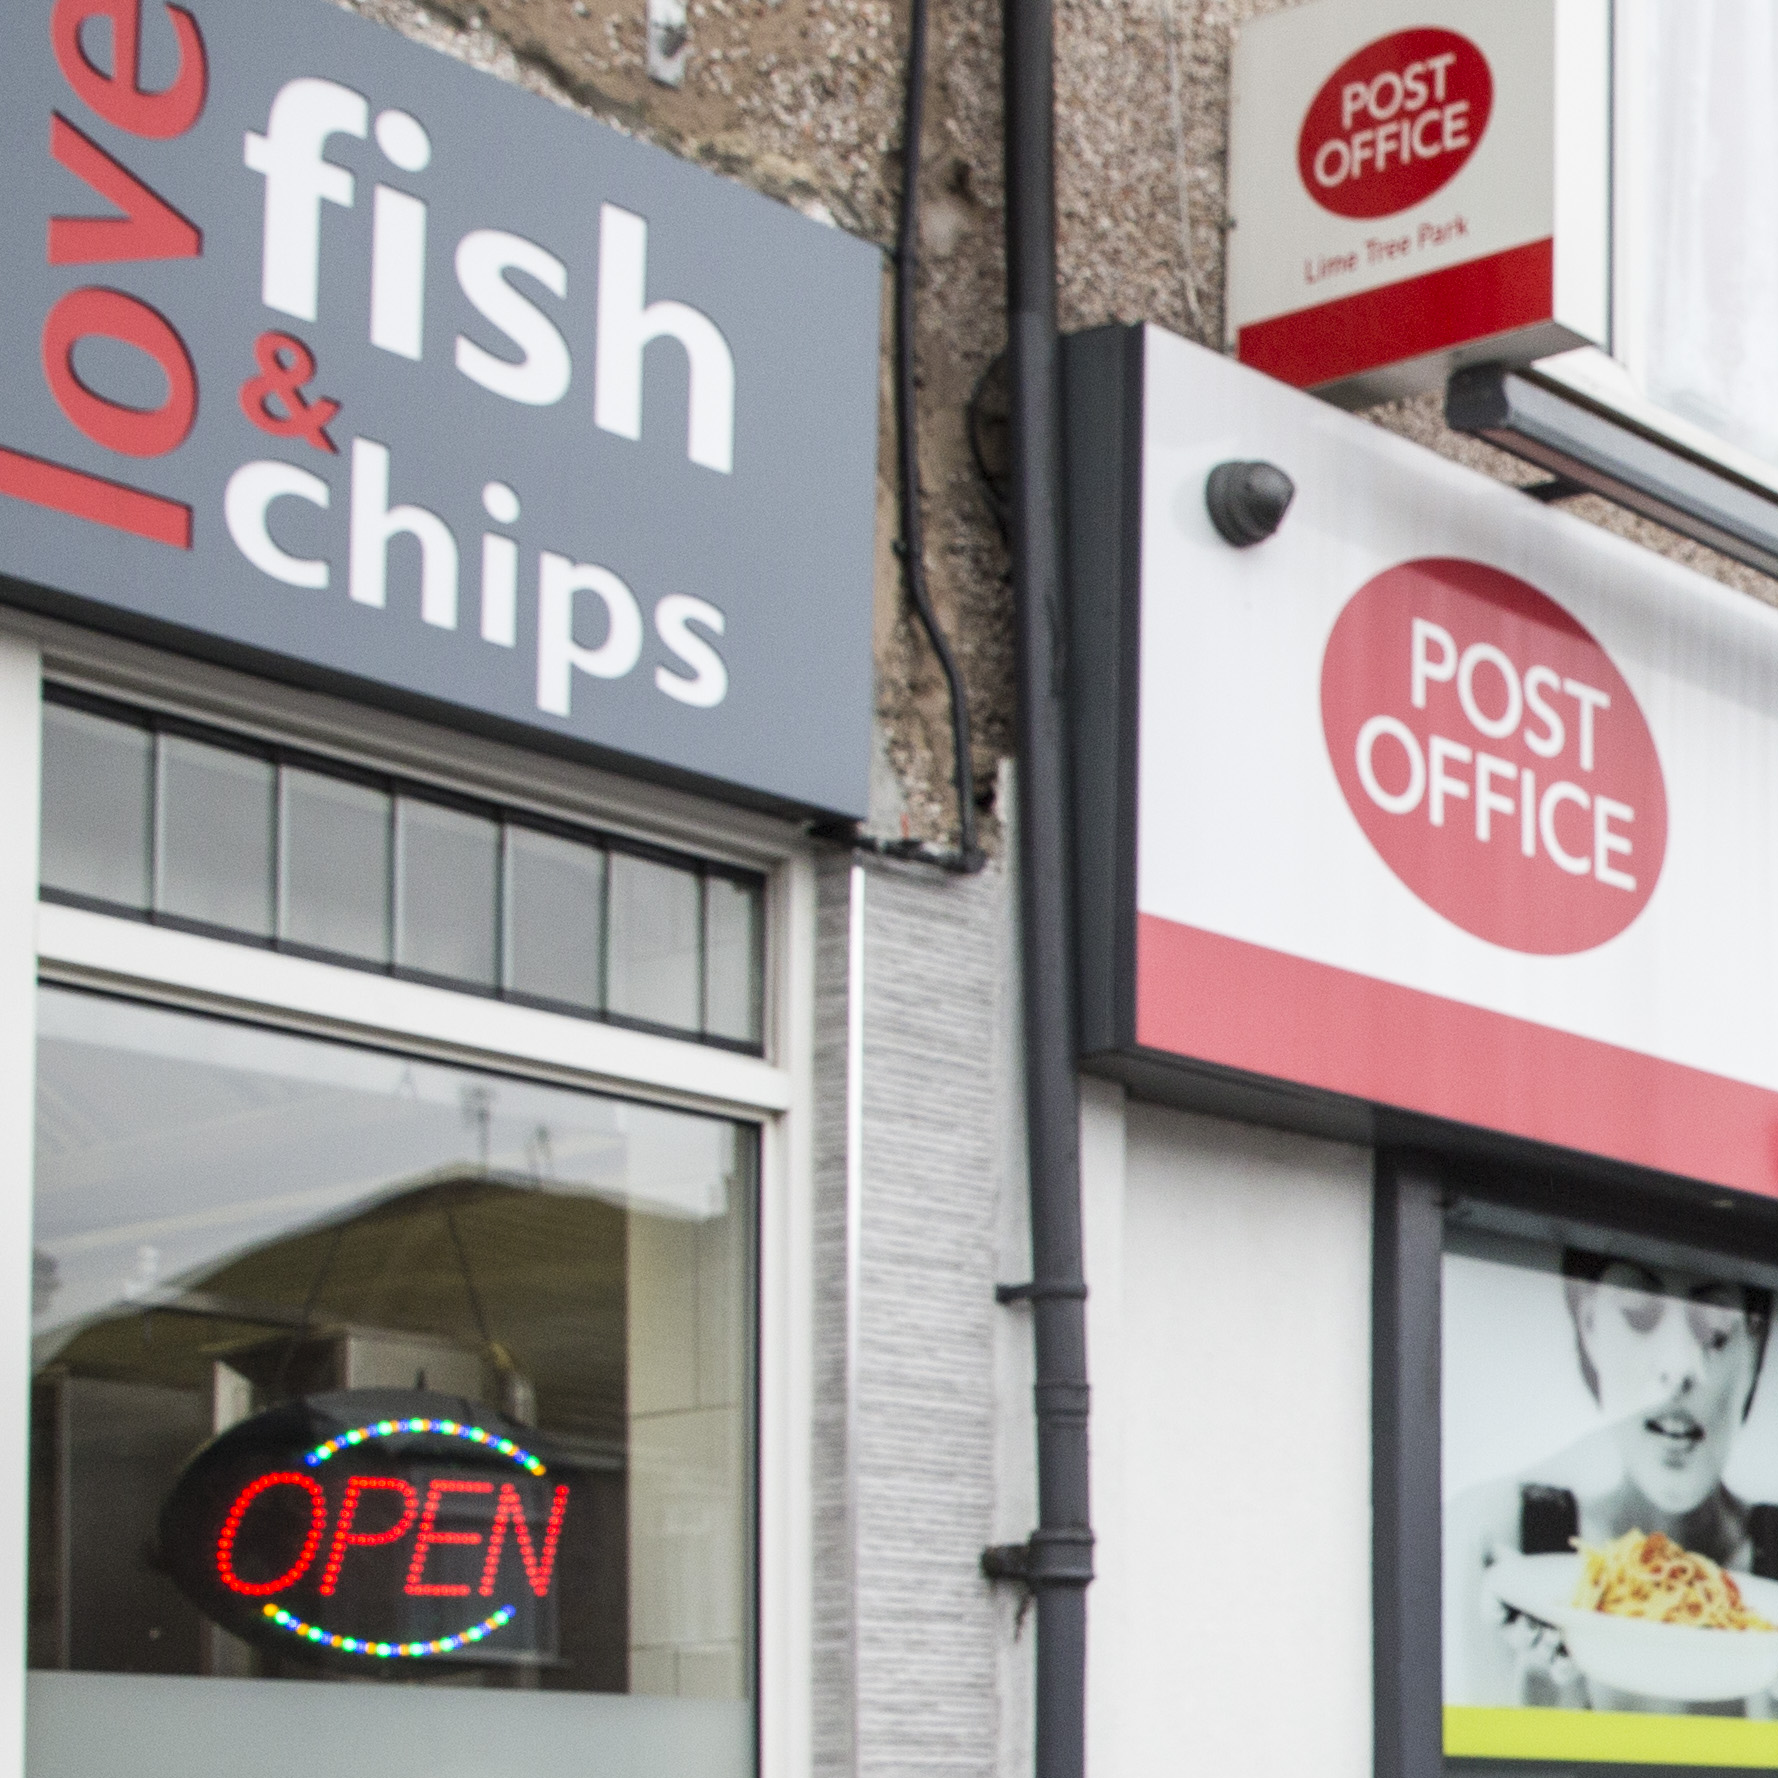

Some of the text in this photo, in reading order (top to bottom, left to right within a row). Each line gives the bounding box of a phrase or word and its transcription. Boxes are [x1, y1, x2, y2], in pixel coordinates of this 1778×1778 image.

[1312, 101, 1471, 188] OFFICE
[1341, 52, 1457, 131] POST
[244, 77, 735, 475] fish
[1303, 213, 1468, 285] Lime Tree Park
[239, 330, 341, 454] &
[224, 437, 729, 717] chips
[1411, 617, 1611, 772] POST
[1355, 714, 1637, 892] OFFICE
[217, 1471, 570, 1596] OPEN
